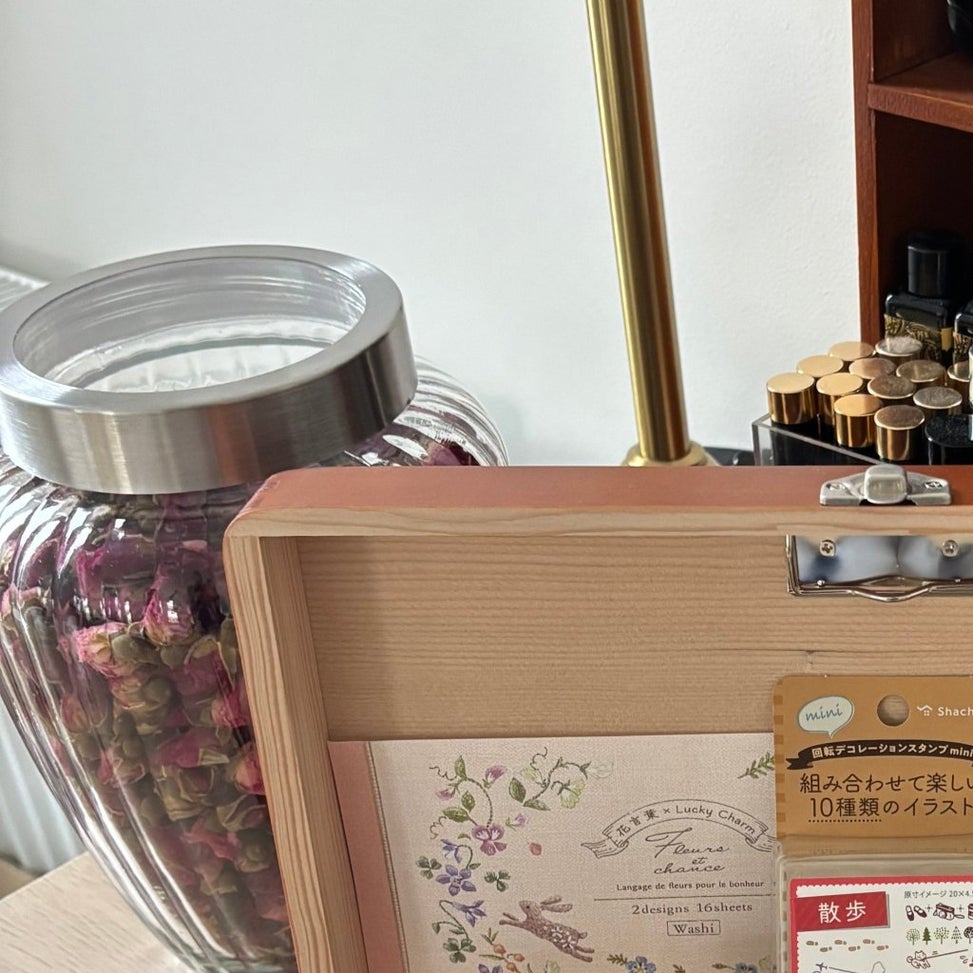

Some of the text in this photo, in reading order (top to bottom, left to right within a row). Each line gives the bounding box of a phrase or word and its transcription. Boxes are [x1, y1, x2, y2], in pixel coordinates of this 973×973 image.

[805, 703, 843, 722] mini
[809, 797, 973, 818] 10種類のイラスト
[676, 805, 713, 819] Lucky
[718, 809, 756, 835] Charm
[617, 883, 652, 892] Langage
[655, 882, 666, 890] de
[668, 881, 693, 890] fleurs
[696, 882, 715, 890] pour
[729, 880, 764, 888] bonheur
[818, 899, 866, 925] 散歩
[673, 922, 715, 934] Washi
